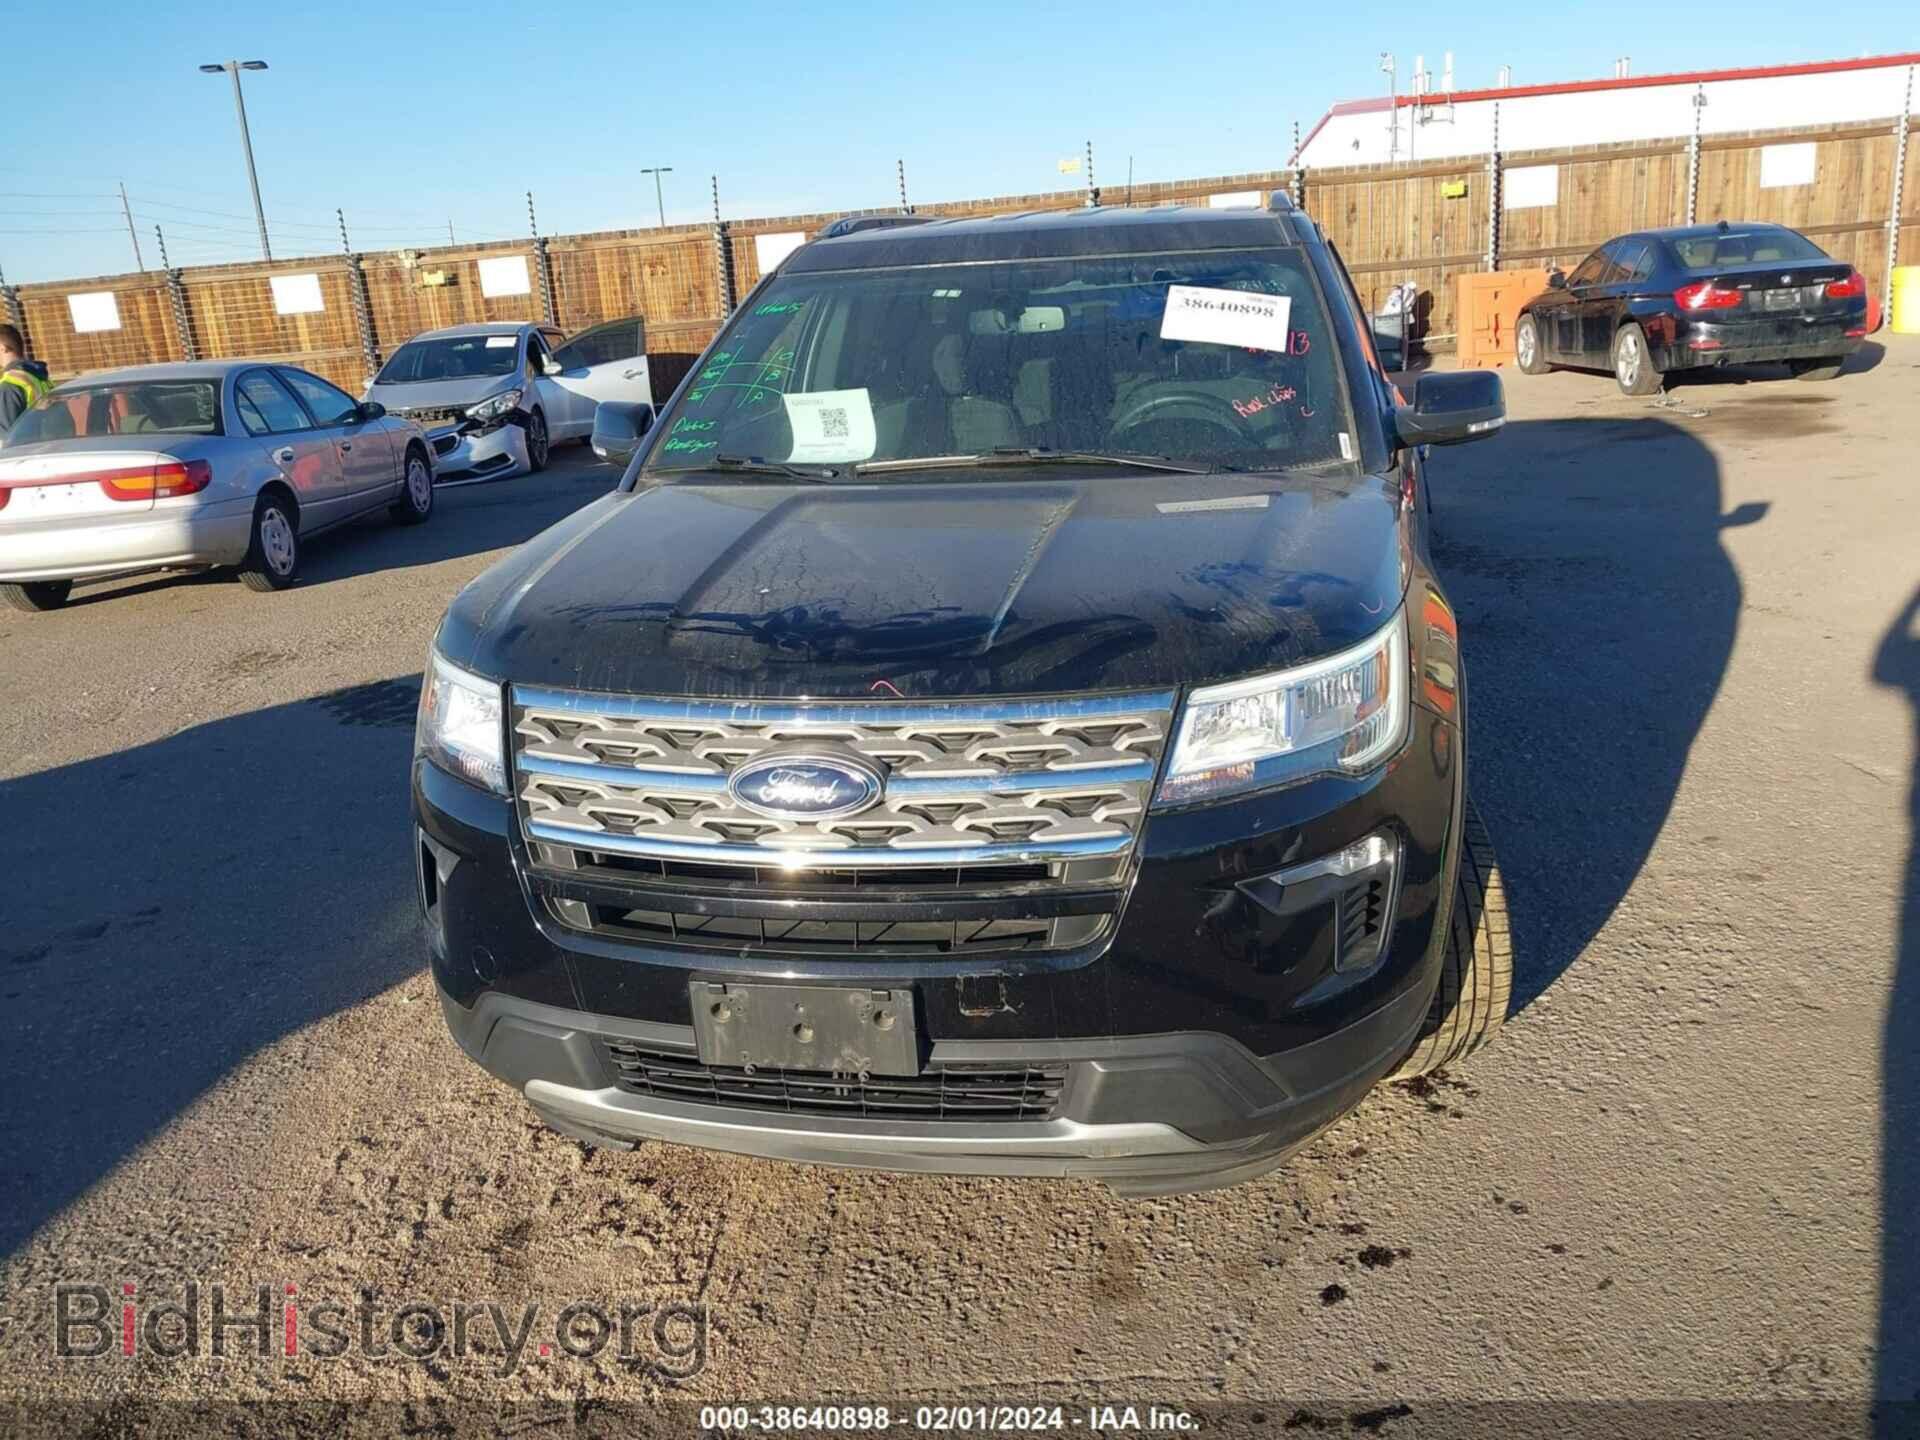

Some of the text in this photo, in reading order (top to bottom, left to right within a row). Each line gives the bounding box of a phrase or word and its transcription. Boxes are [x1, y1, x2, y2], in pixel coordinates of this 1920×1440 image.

[1183, 297, 1275, 318] 38640898
[1288, 330, 1311, 355] 13
[758, 768, 841, 806] Ford
